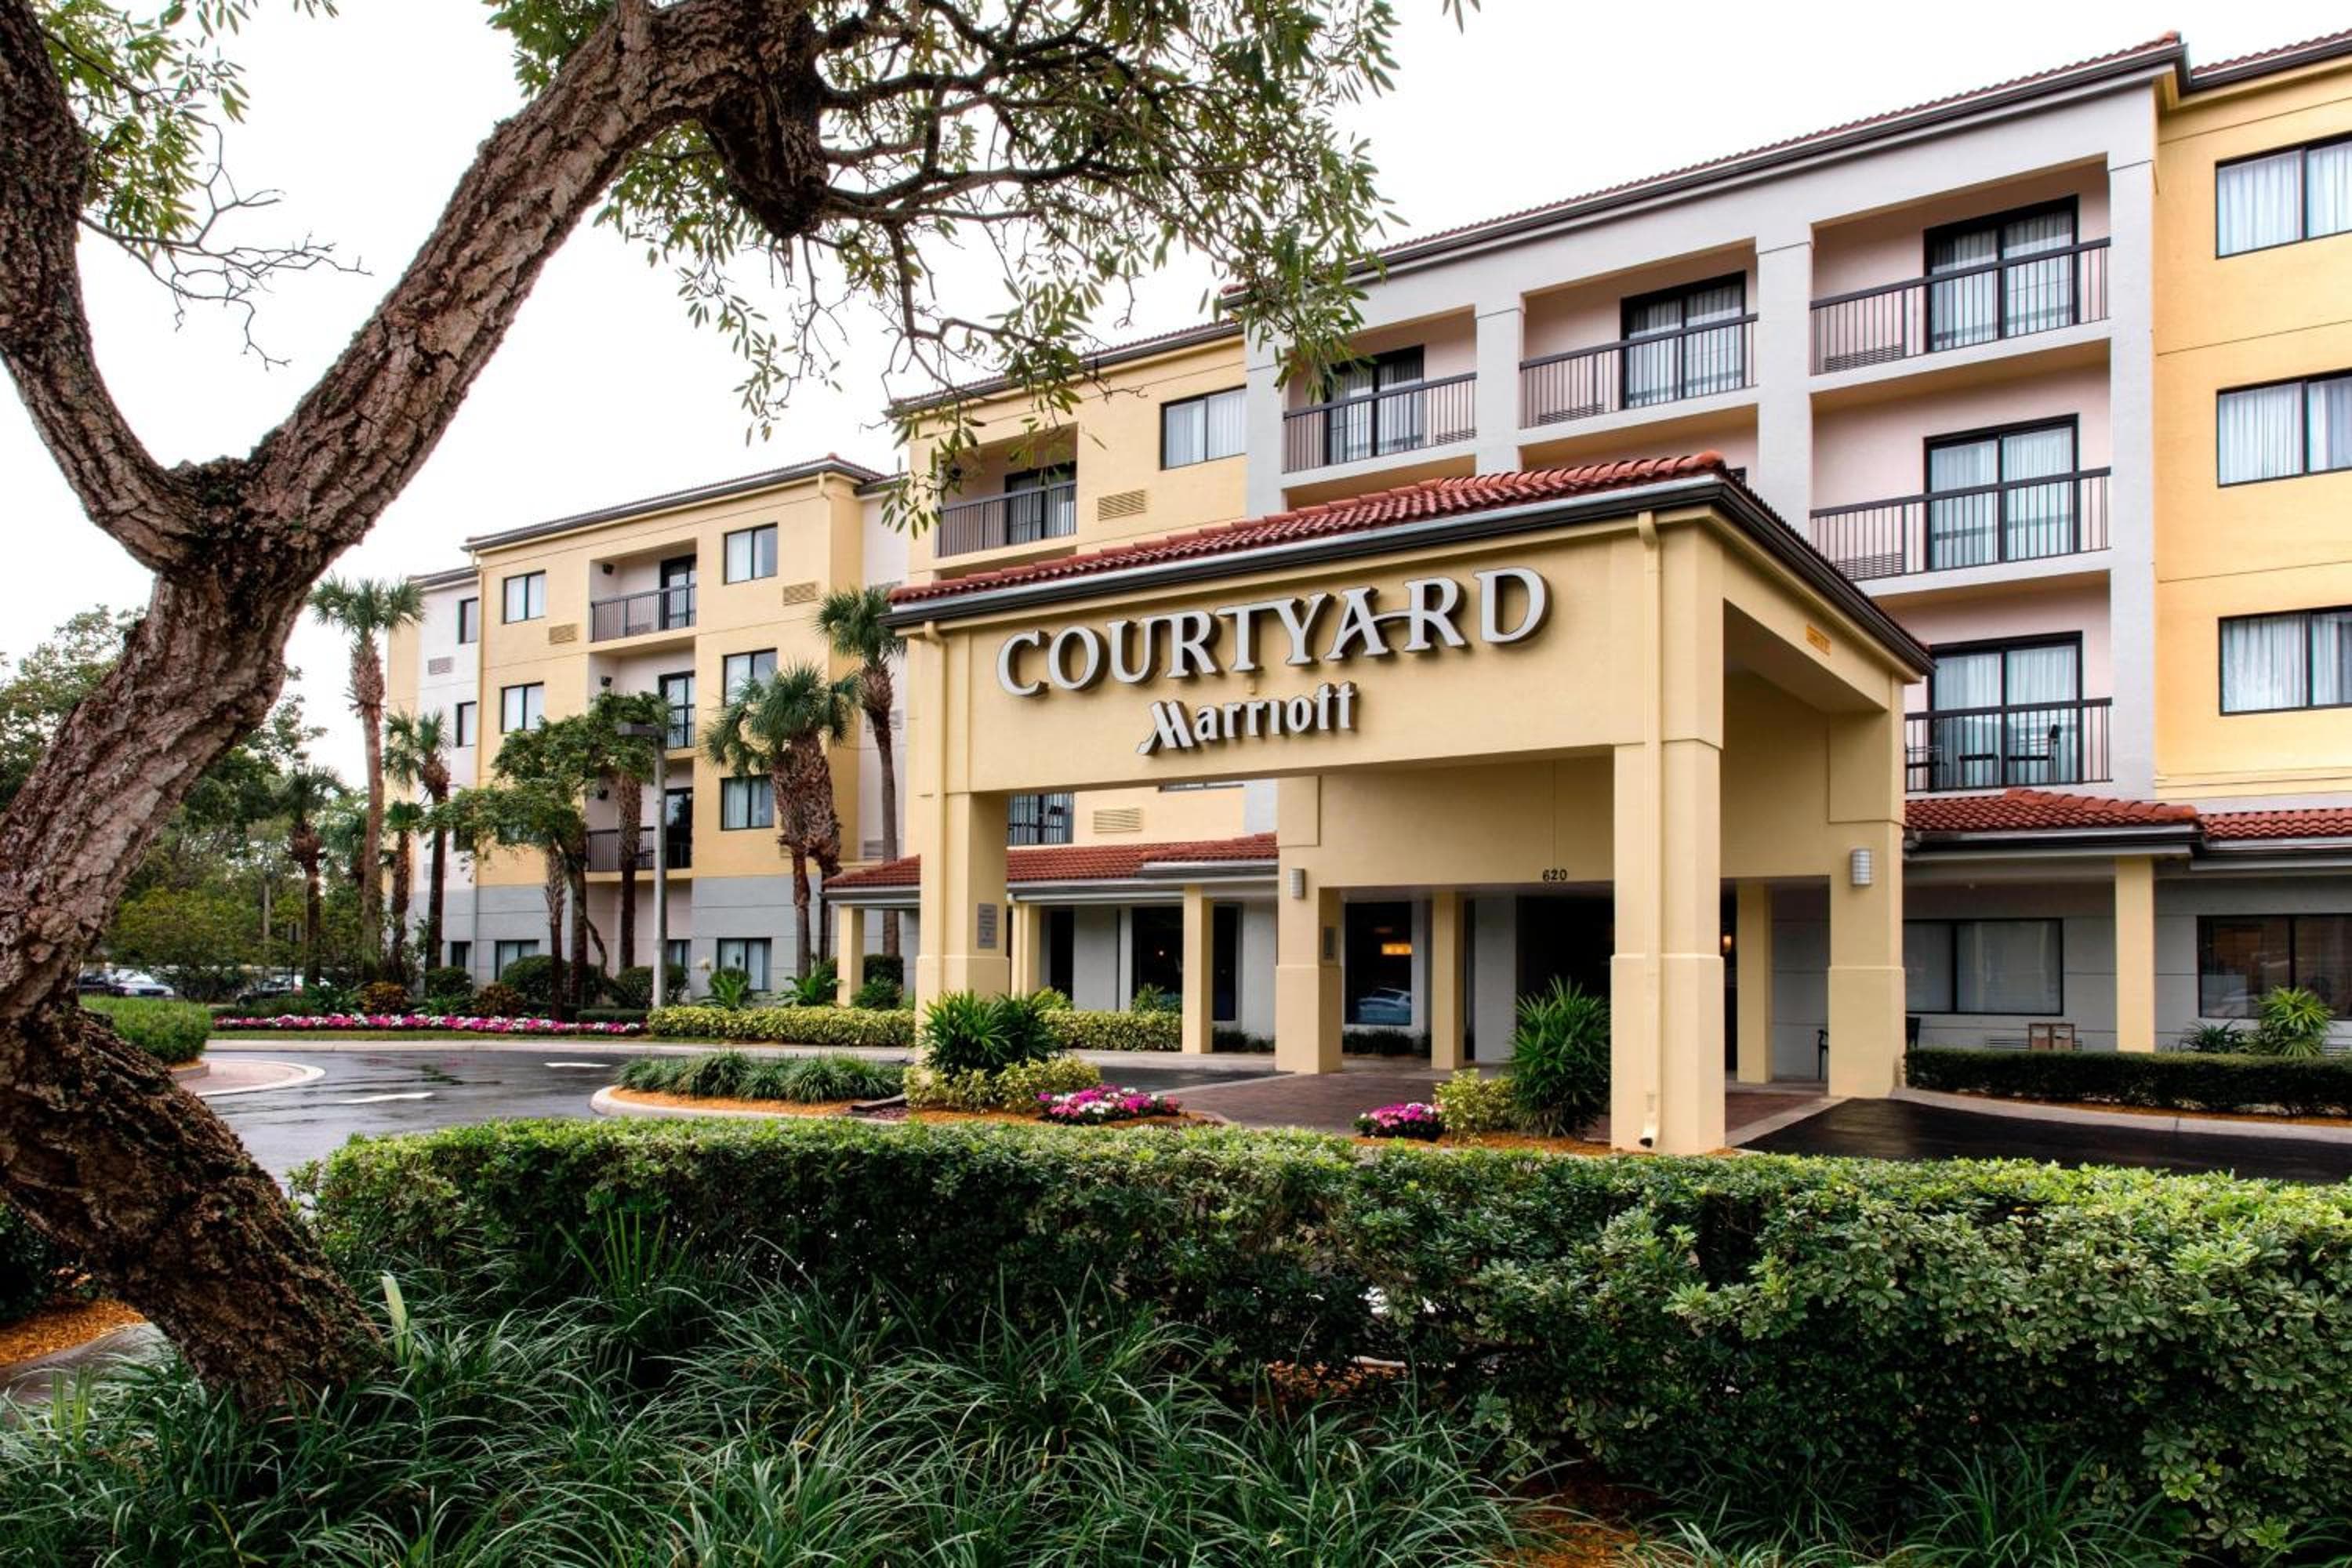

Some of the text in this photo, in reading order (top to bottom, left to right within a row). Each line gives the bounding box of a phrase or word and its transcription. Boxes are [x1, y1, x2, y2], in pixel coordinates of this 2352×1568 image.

[996, 567, 1550, 697] COURTYARD
[1136, 681, 1357, 754] Marriott
[1542, 868, 1567, 881] 620
